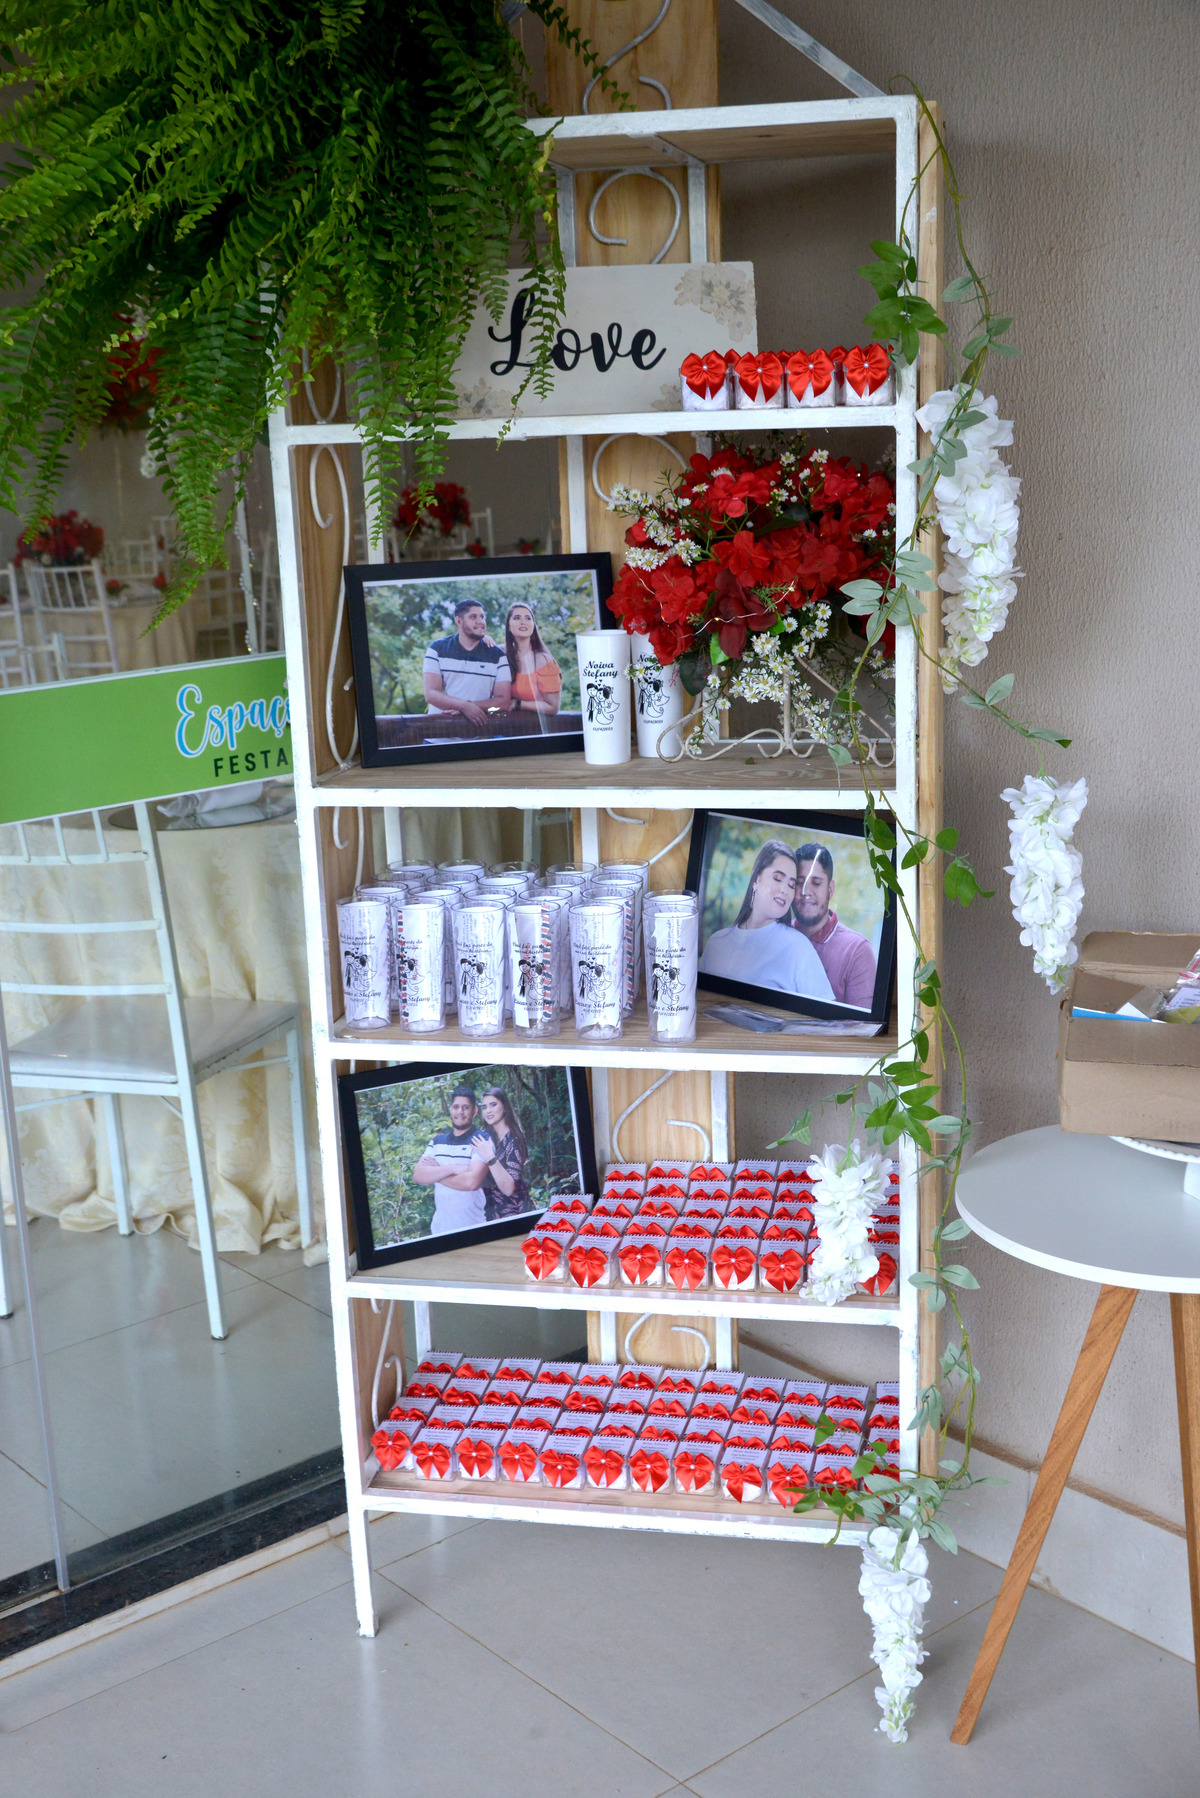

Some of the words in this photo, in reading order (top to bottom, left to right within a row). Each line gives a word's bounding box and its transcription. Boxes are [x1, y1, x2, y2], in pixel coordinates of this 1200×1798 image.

[488, 288, 667, 376] Love
[582, 668, 619, 680] Stefany
[586, 660, 615, 669] Noiva
[174, 683, 290, 758] Espaç
